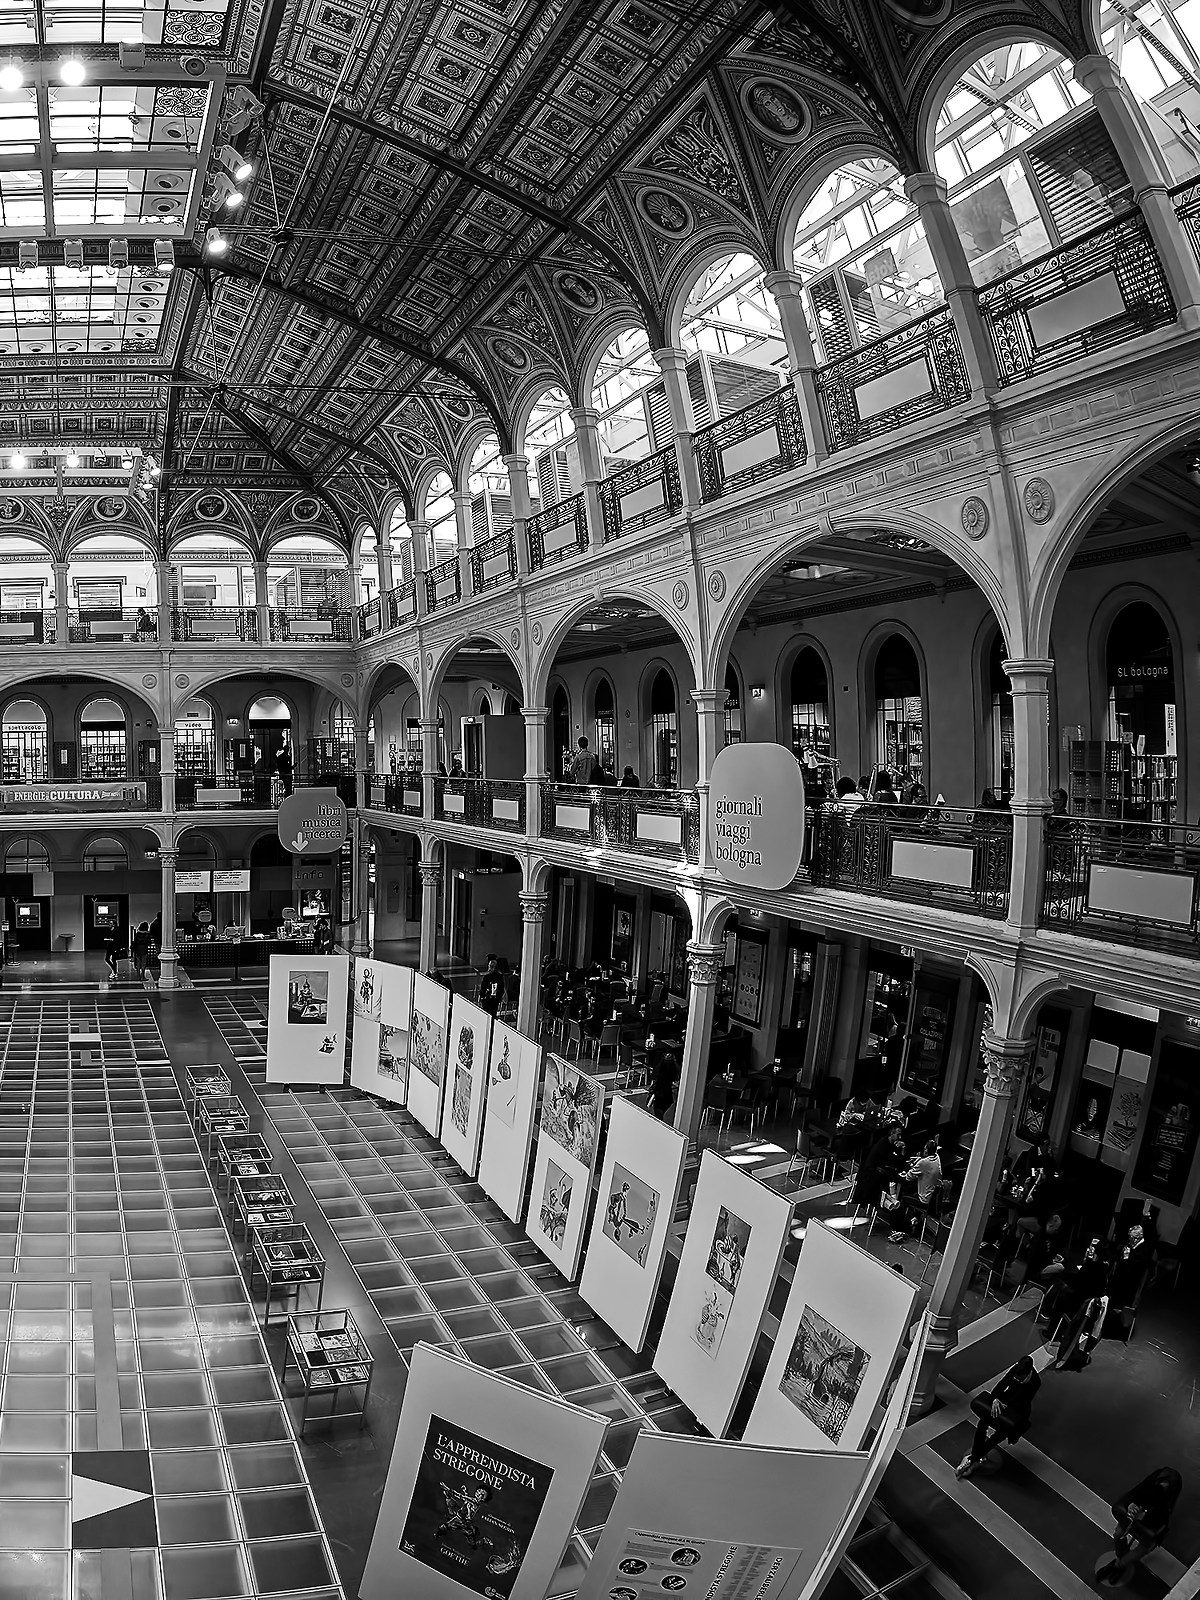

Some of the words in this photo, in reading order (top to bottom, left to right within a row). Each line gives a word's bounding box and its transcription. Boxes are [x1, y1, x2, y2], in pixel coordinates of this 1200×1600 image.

[1117, 667, 1128, 678] SL
[1130, 666, 1169, 678] bologna
[14, 791, 46, 801] ENERGIE
[49, 790, 101, 801] CULTURA
[317, 804, 342, 816] libri
[716, 795, 763, 819] giornali
[301, 816, 342, 828] musica
[304, 827, 342, 839] ricerca
[716, 818, 751, 845] viaggi
[716, 841, 762, 868] bologna
[295, 870, 324, 880] info
[432, 1447, 504, 1490] STREGONE
[436, 1432, 536, 1491] L'APPRENDISTA
[716, 1545, 738, 1580] STREGONE
